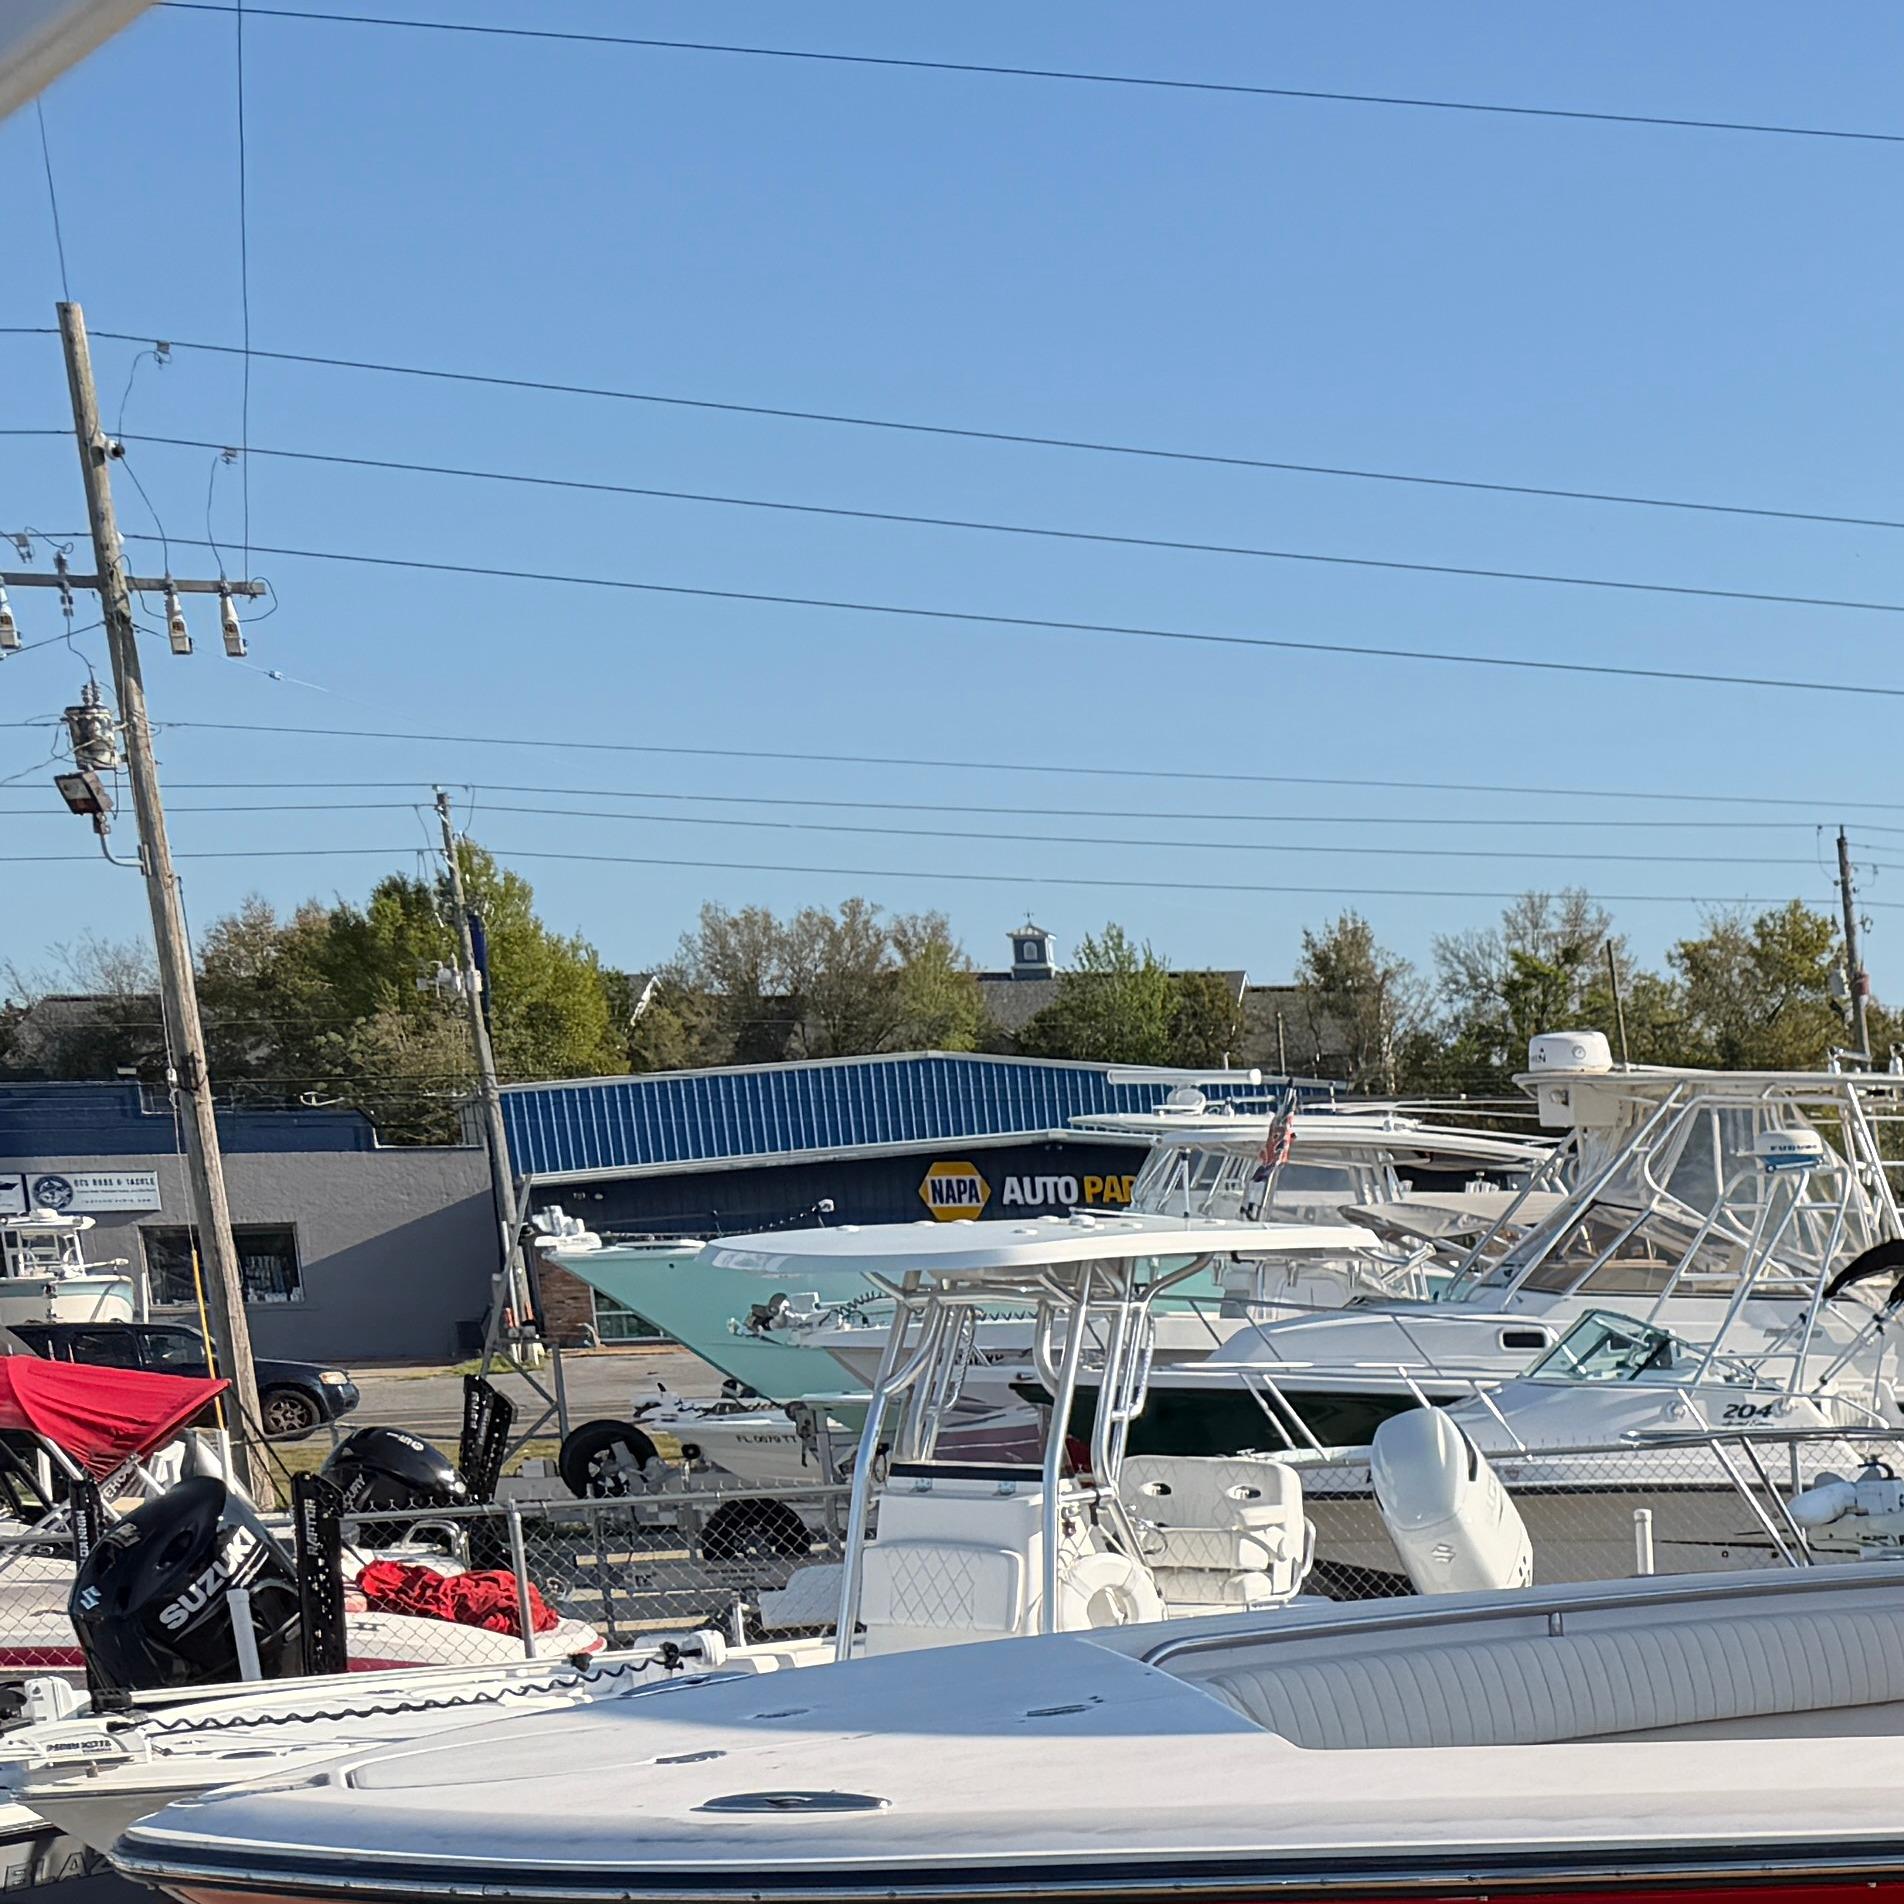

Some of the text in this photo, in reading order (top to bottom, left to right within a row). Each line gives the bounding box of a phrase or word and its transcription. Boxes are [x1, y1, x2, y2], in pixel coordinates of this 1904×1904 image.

[930, 1177, 981, 1204] NAPA
[1002, 1175, 1079, 1206] AUTO
[1722, 1403, 1772, 1419] 204
[159, 1525, 256, 1629] SUZUKI
